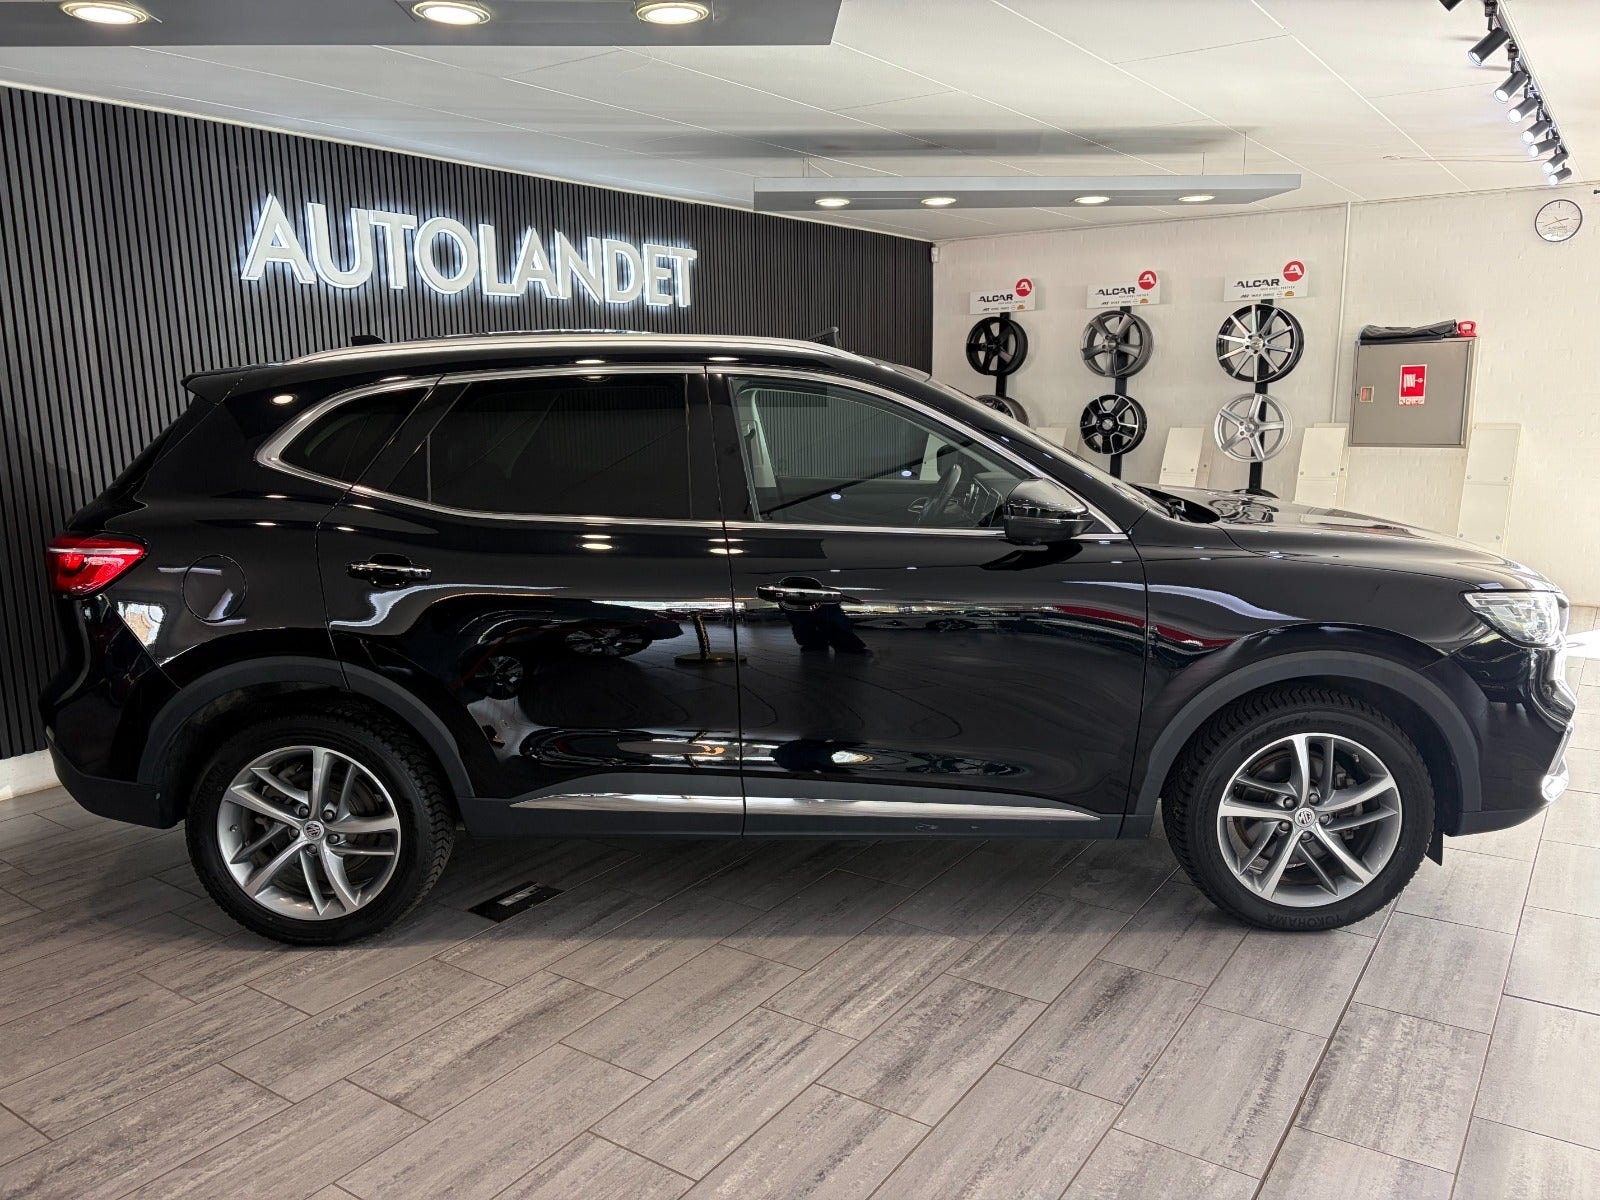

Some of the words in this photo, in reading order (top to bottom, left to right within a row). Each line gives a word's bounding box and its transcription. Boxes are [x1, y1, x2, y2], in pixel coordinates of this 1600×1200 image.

[240, 192, 698, 309] AUTOLANDET
[1233, 278, 1280, 289] ALCAR
[1095, 286, 1136, 296] ALCAR
[977, 293, 1014, 303] ALCAR
[1266, 911, 1344, 929] YOKOHAMA
